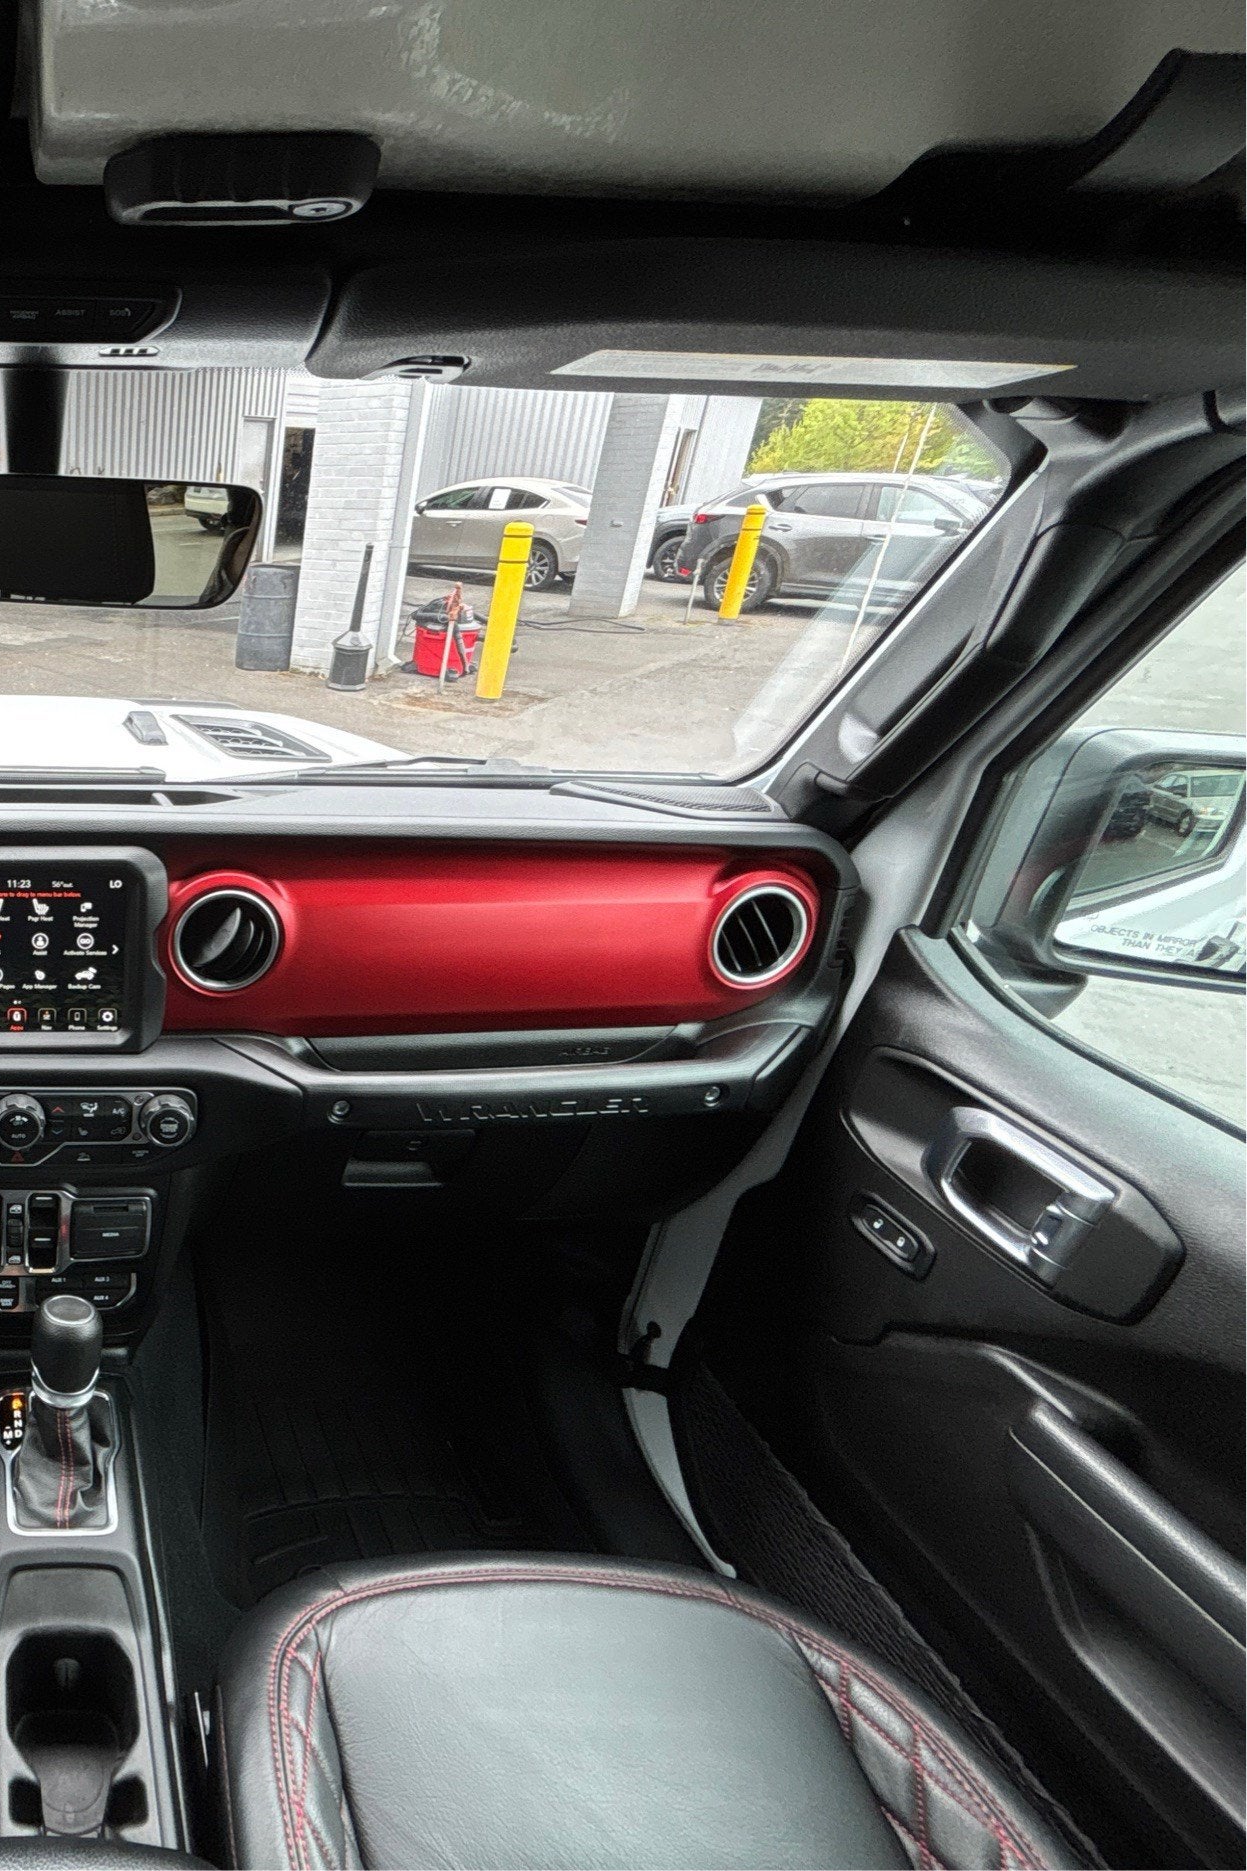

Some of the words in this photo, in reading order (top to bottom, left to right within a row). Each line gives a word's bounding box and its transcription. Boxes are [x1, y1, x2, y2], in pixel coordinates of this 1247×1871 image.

[7, 880, 32, 888] 11:23
[110, 880, 122, 888] LO
[1090, 924, 1140, 938] OBJECTS
[1143, 932, 1155, 940] IN
[1157, 934, 1197, 946] MIRROR
[1122, 938, 1151, 950] THAN
[1155, 944, 1182, 954] THEY
[416, 1098, 648, 1122] WRANGLER
[14, 1410, 21, 1418] R
[3, 1431, 13, 1439] M
[14, 1430, 22, 1438] D
